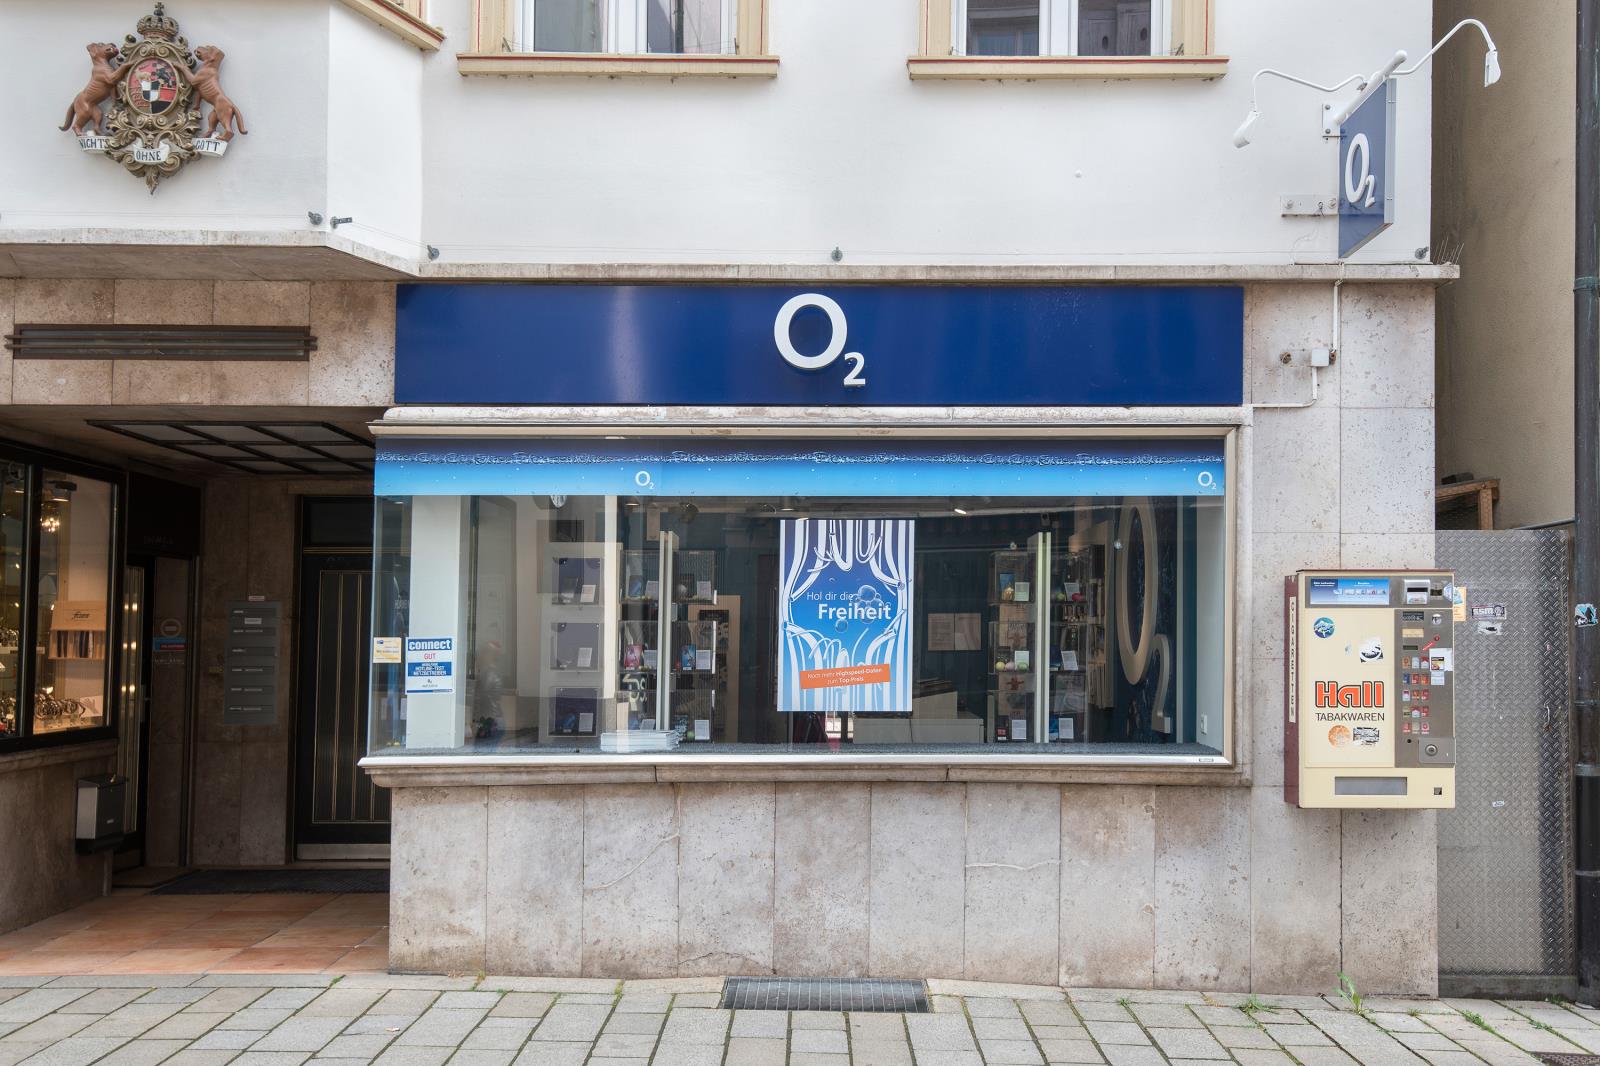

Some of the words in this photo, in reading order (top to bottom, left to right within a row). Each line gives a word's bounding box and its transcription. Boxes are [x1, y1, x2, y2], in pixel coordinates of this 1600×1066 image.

[79, 138, 110, 149] NICHTS
[195, 140, 221, 151] GOTT
[136, 151, 162, 161] OHNE
[1345, 133, 1376, 208] O2
[774, 293, 866, 386] O2
[635, 470, 656, 490] O2
[1198, 471, 1217, 490] O2
[806, 592, 822, 601] Hol
[825, 592, 837, 601] dir
[840, 592, 854, 601] die
[818, 603, 892, 620] Freiheit
[408, 640, 451, 651] connect
[1315, 680, 1385, 708] Hall
[1315, 712, 1385, 721] TABAKWAREN
